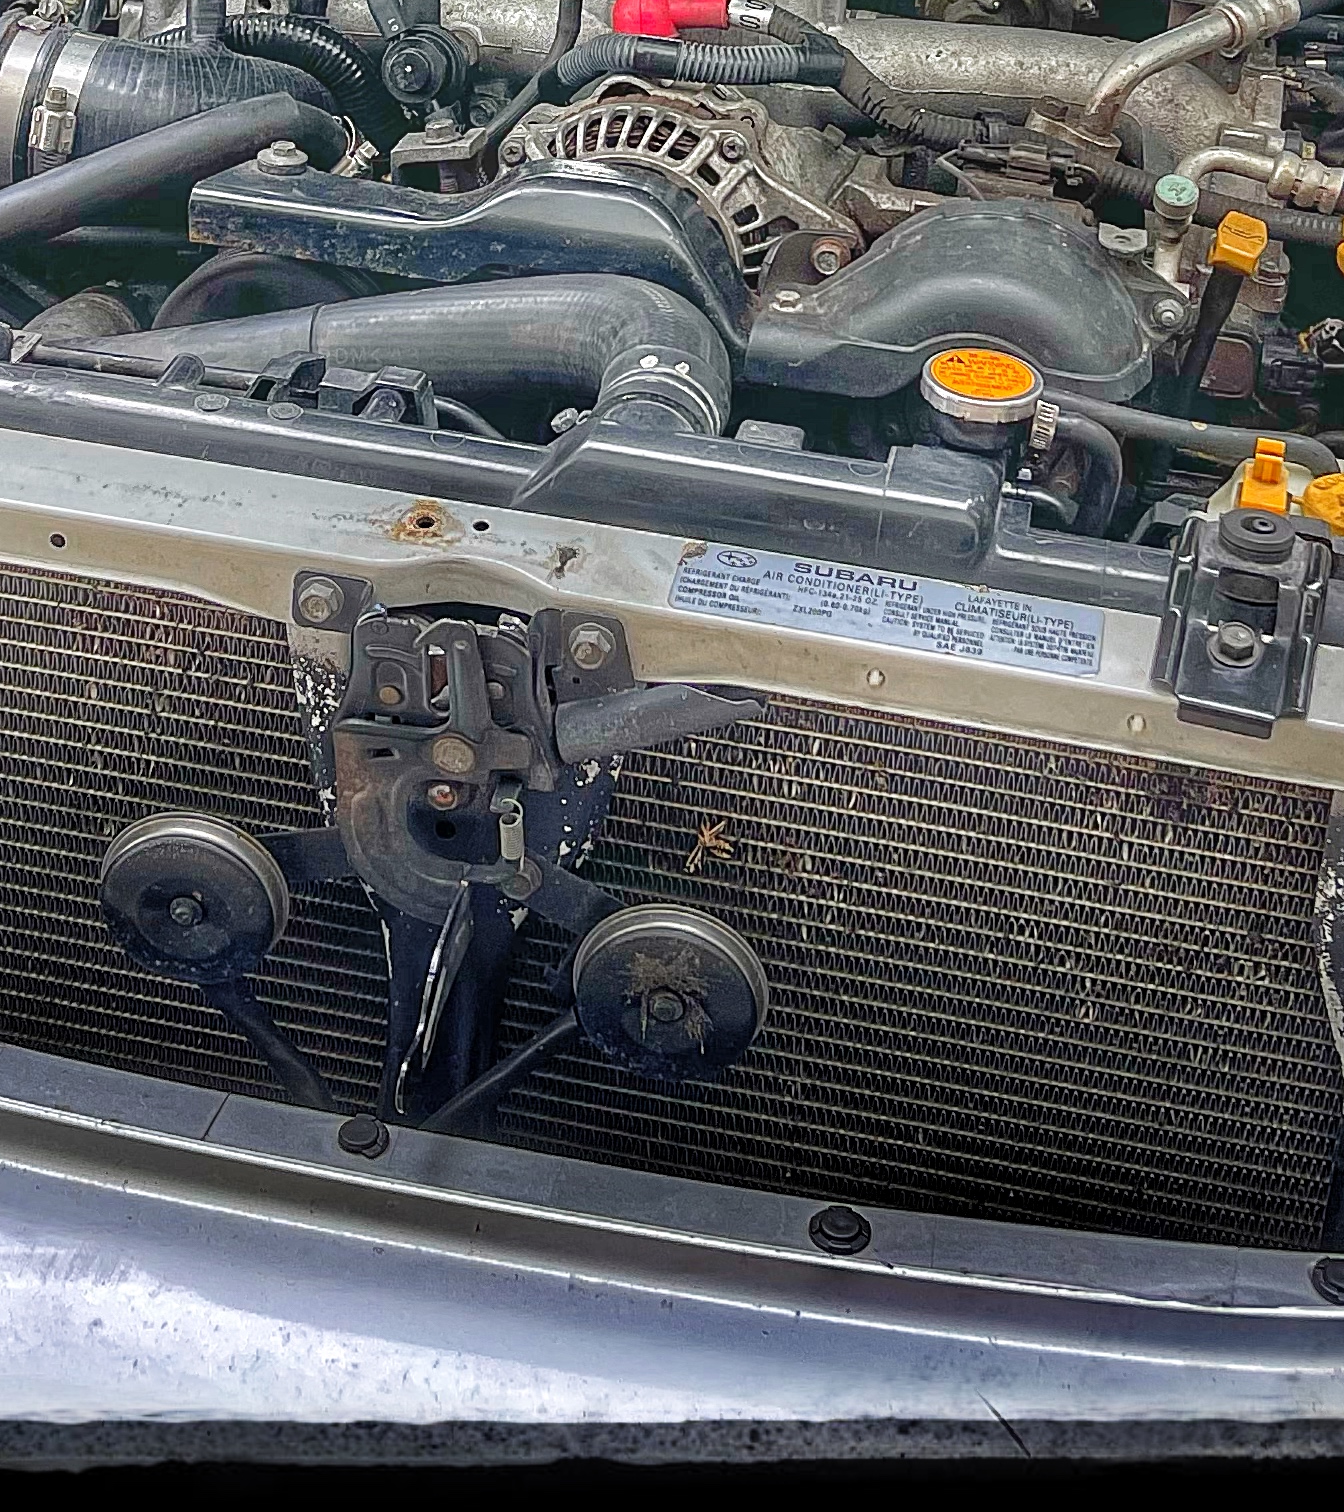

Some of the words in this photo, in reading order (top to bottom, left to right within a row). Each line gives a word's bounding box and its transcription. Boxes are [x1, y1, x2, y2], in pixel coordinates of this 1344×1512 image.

[683, 567, 731, 581] REFRIGERANT
[763, 570, 783, 581] AIR
[793, 562, 918, 591] SUBARU
[678, 585, 727, 599] COMPRESSOR
[728, 593, 740, 602] OIL
[730, 583, 740, 592] DU
[697, 598, 708, 607] DU
[968, 594, 1020, 611] LAFAYETTE
[936, 640, 956, 651] SAE
